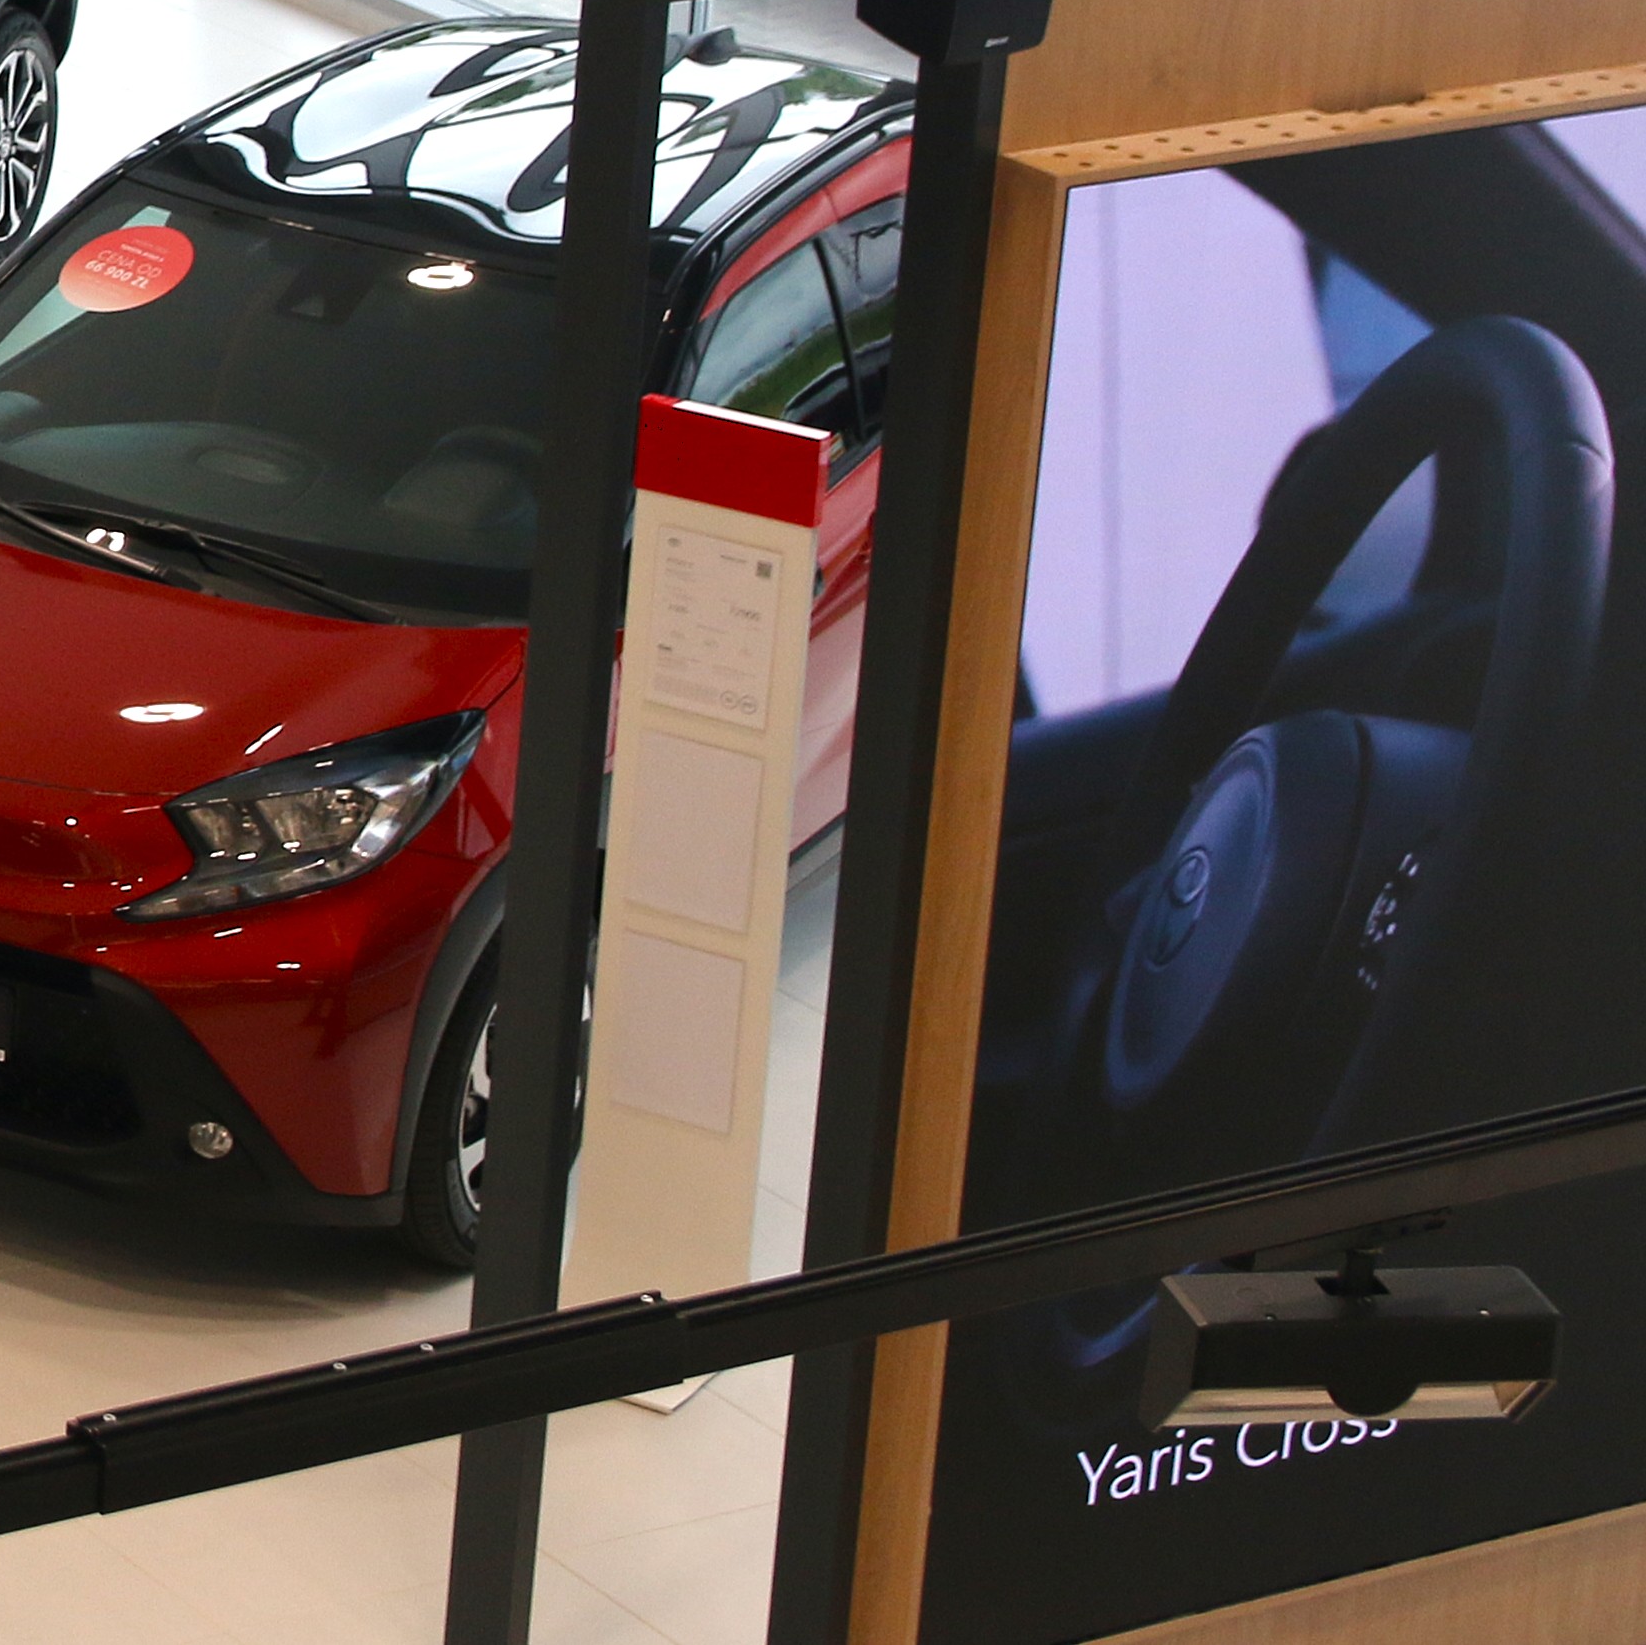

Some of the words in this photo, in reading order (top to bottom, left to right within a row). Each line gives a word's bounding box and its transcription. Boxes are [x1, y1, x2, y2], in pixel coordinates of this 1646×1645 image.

[84, 260, 106, 273] 66
[104, 265, 133, 282] 900
[96, 249, 136, 269] CENA
[137, 262, 162, 279] OD
[1077, 1428, 1215, 1506] Yaris
